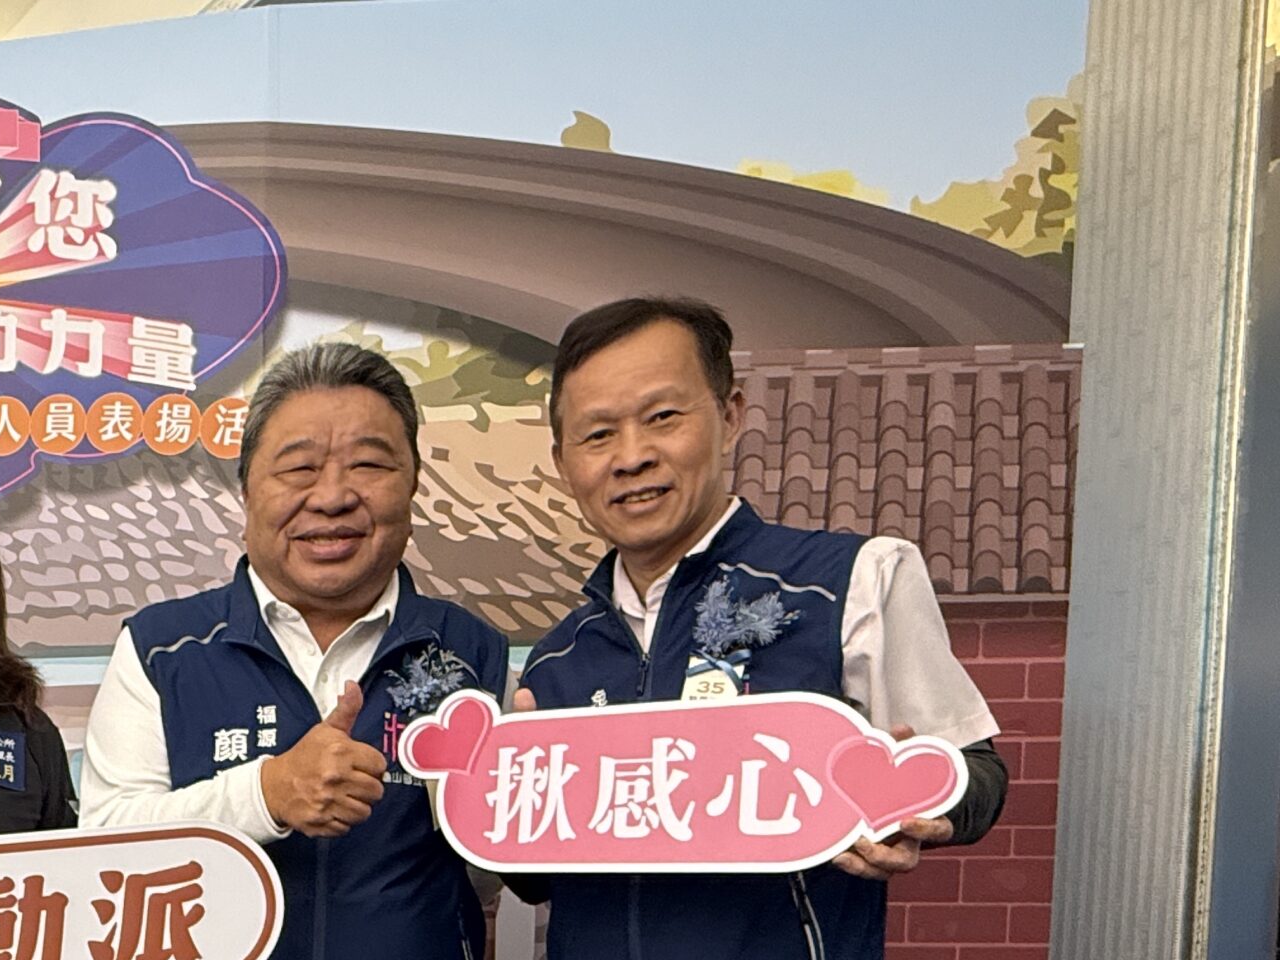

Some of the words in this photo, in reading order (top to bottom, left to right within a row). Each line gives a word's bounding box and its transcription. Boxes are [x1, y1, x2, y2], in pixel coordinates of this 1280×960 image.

[696, 681, 725, 694] 35
[483, 733, 823, 844] 揪感心
